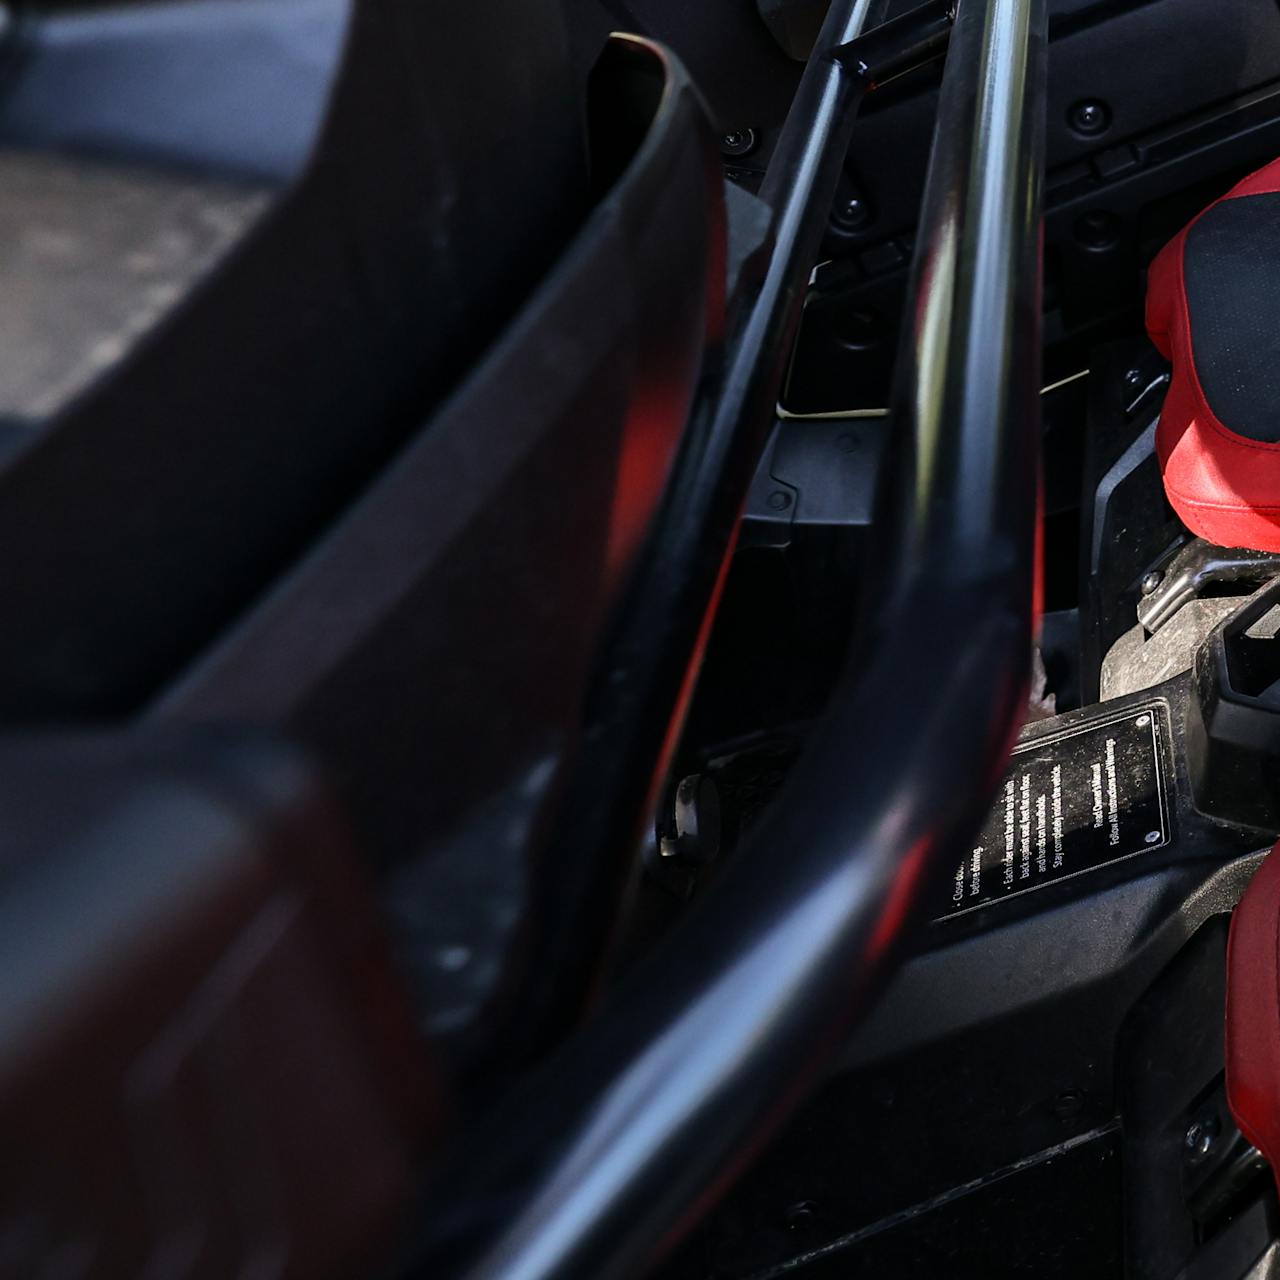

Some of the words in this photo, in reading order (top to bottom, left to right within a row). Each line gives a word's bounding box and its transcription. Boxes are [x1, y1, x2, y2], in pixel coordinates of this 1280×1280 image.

[1105, 739, 1116, 766] Warnings
[1051, 764, 1061, 787] vehicle.
[1090, 763, 1101, 787] Manual
[1105, 766, 1115, 778] and
[1005, 781, 1014, 795] with
[1022, 790, 1030, 799] on
[1052, 787, 1061, 798] the
[1107, 778, 1118, 814] Instructions
[1004, 794, 1014, 803] sit
[1020, 798, 1029, 810] flat
[1092, 785, 1102, 811] Owner's
[1020, 809, 1030, 823] feet
[1036, 794, 1046, 830] handholds.
[1052, 798, 1061, 818] inside
[1004, 810, 1014, 824] able
[1092, 810, 1103, 828] Read
[1108, 814, 1118, 822] All
[1004, 824, 1014, 835] be
[1020, 822, 1030, 837] seat,
[1038, 829, 1046, 838] on
[1052, 817, 1064, 852] completely
[1110, 823, 1119, 845] Follow
[1005, 832, 1014, 851] must
[1020, 837, 1032, 861] against
[1036, 838, 1046, 859] hands
[1002, 851, 1013, 866] rider
[1036, 859, 1046, 872] and
[1053, 852, 1064, 868] Stay
[1004, 867, 1013, 884] Each
[1020, 861, 1029, 879] back
[953, 881, 963, 900] Close
[970, 872, 980, 896] before
